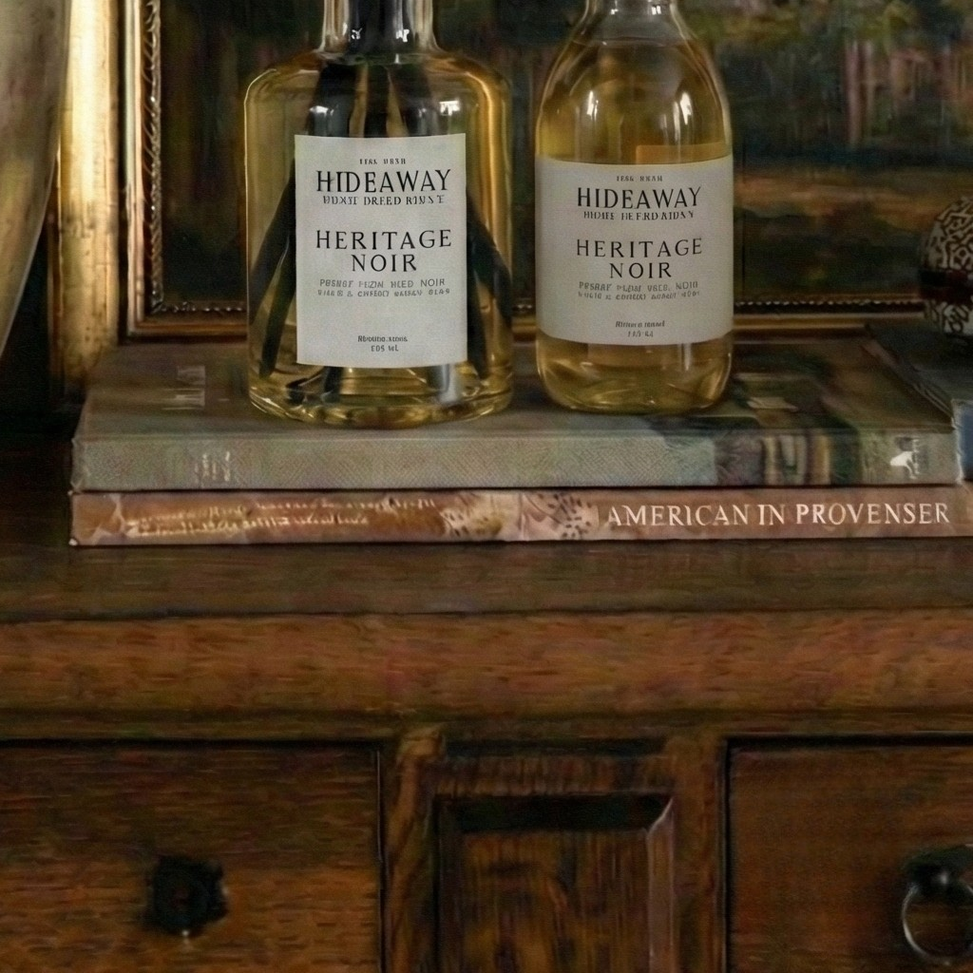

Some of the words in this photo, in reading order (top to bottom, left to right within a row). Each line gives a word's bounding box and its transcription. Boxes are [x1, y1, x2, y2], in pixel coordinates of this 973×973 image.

[316, 169, 451, 193] HIDEAWAY
[577, 186, 701, 209] HIDEAWAY
[316, 229, 452, 250] HERITAGE
[576, 237, 703, 258] HERITAGE
[351, 254, 417, 272] NOIR
[609, 262, 672, 279] NOIR
[420, 278, 445, 287] NOIR
[608, 503, 750, 527] AMERICAN
[758, 503, 786, 525] IN
[796, 502, 950, 525] PROVENSER
